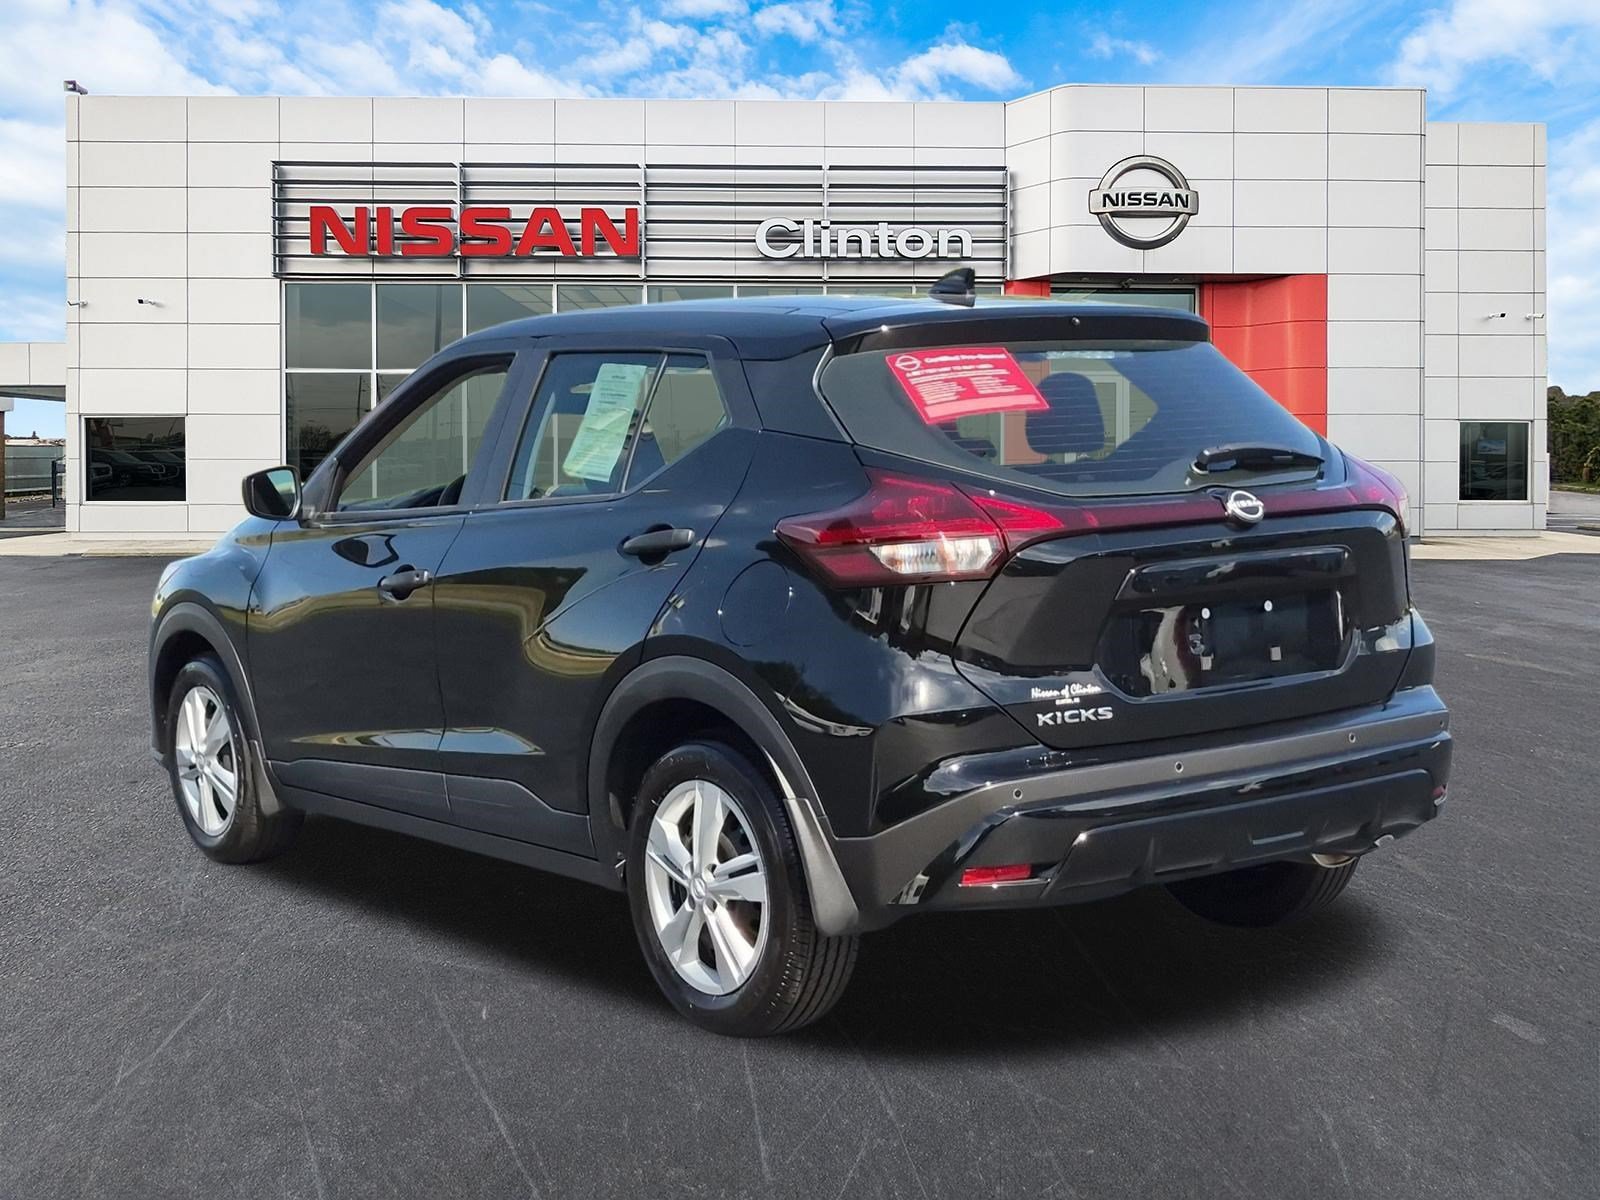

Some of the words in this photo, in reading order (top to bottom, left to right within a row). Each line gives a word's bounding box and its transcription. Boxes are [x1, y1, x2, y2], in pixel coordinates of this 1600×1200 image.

[1102, 191, 1189, 208] NISSAN
[310, 206, 640, 257] NISSAN
[755, 217, 973, 258] Clinton
[1031, 687, 1060, 699] Nissan
[1060, 684, 1070, 699] of
[1070, 683, 1102, 695] Clinton
[1036, 706, 1113, 727] KICKS
